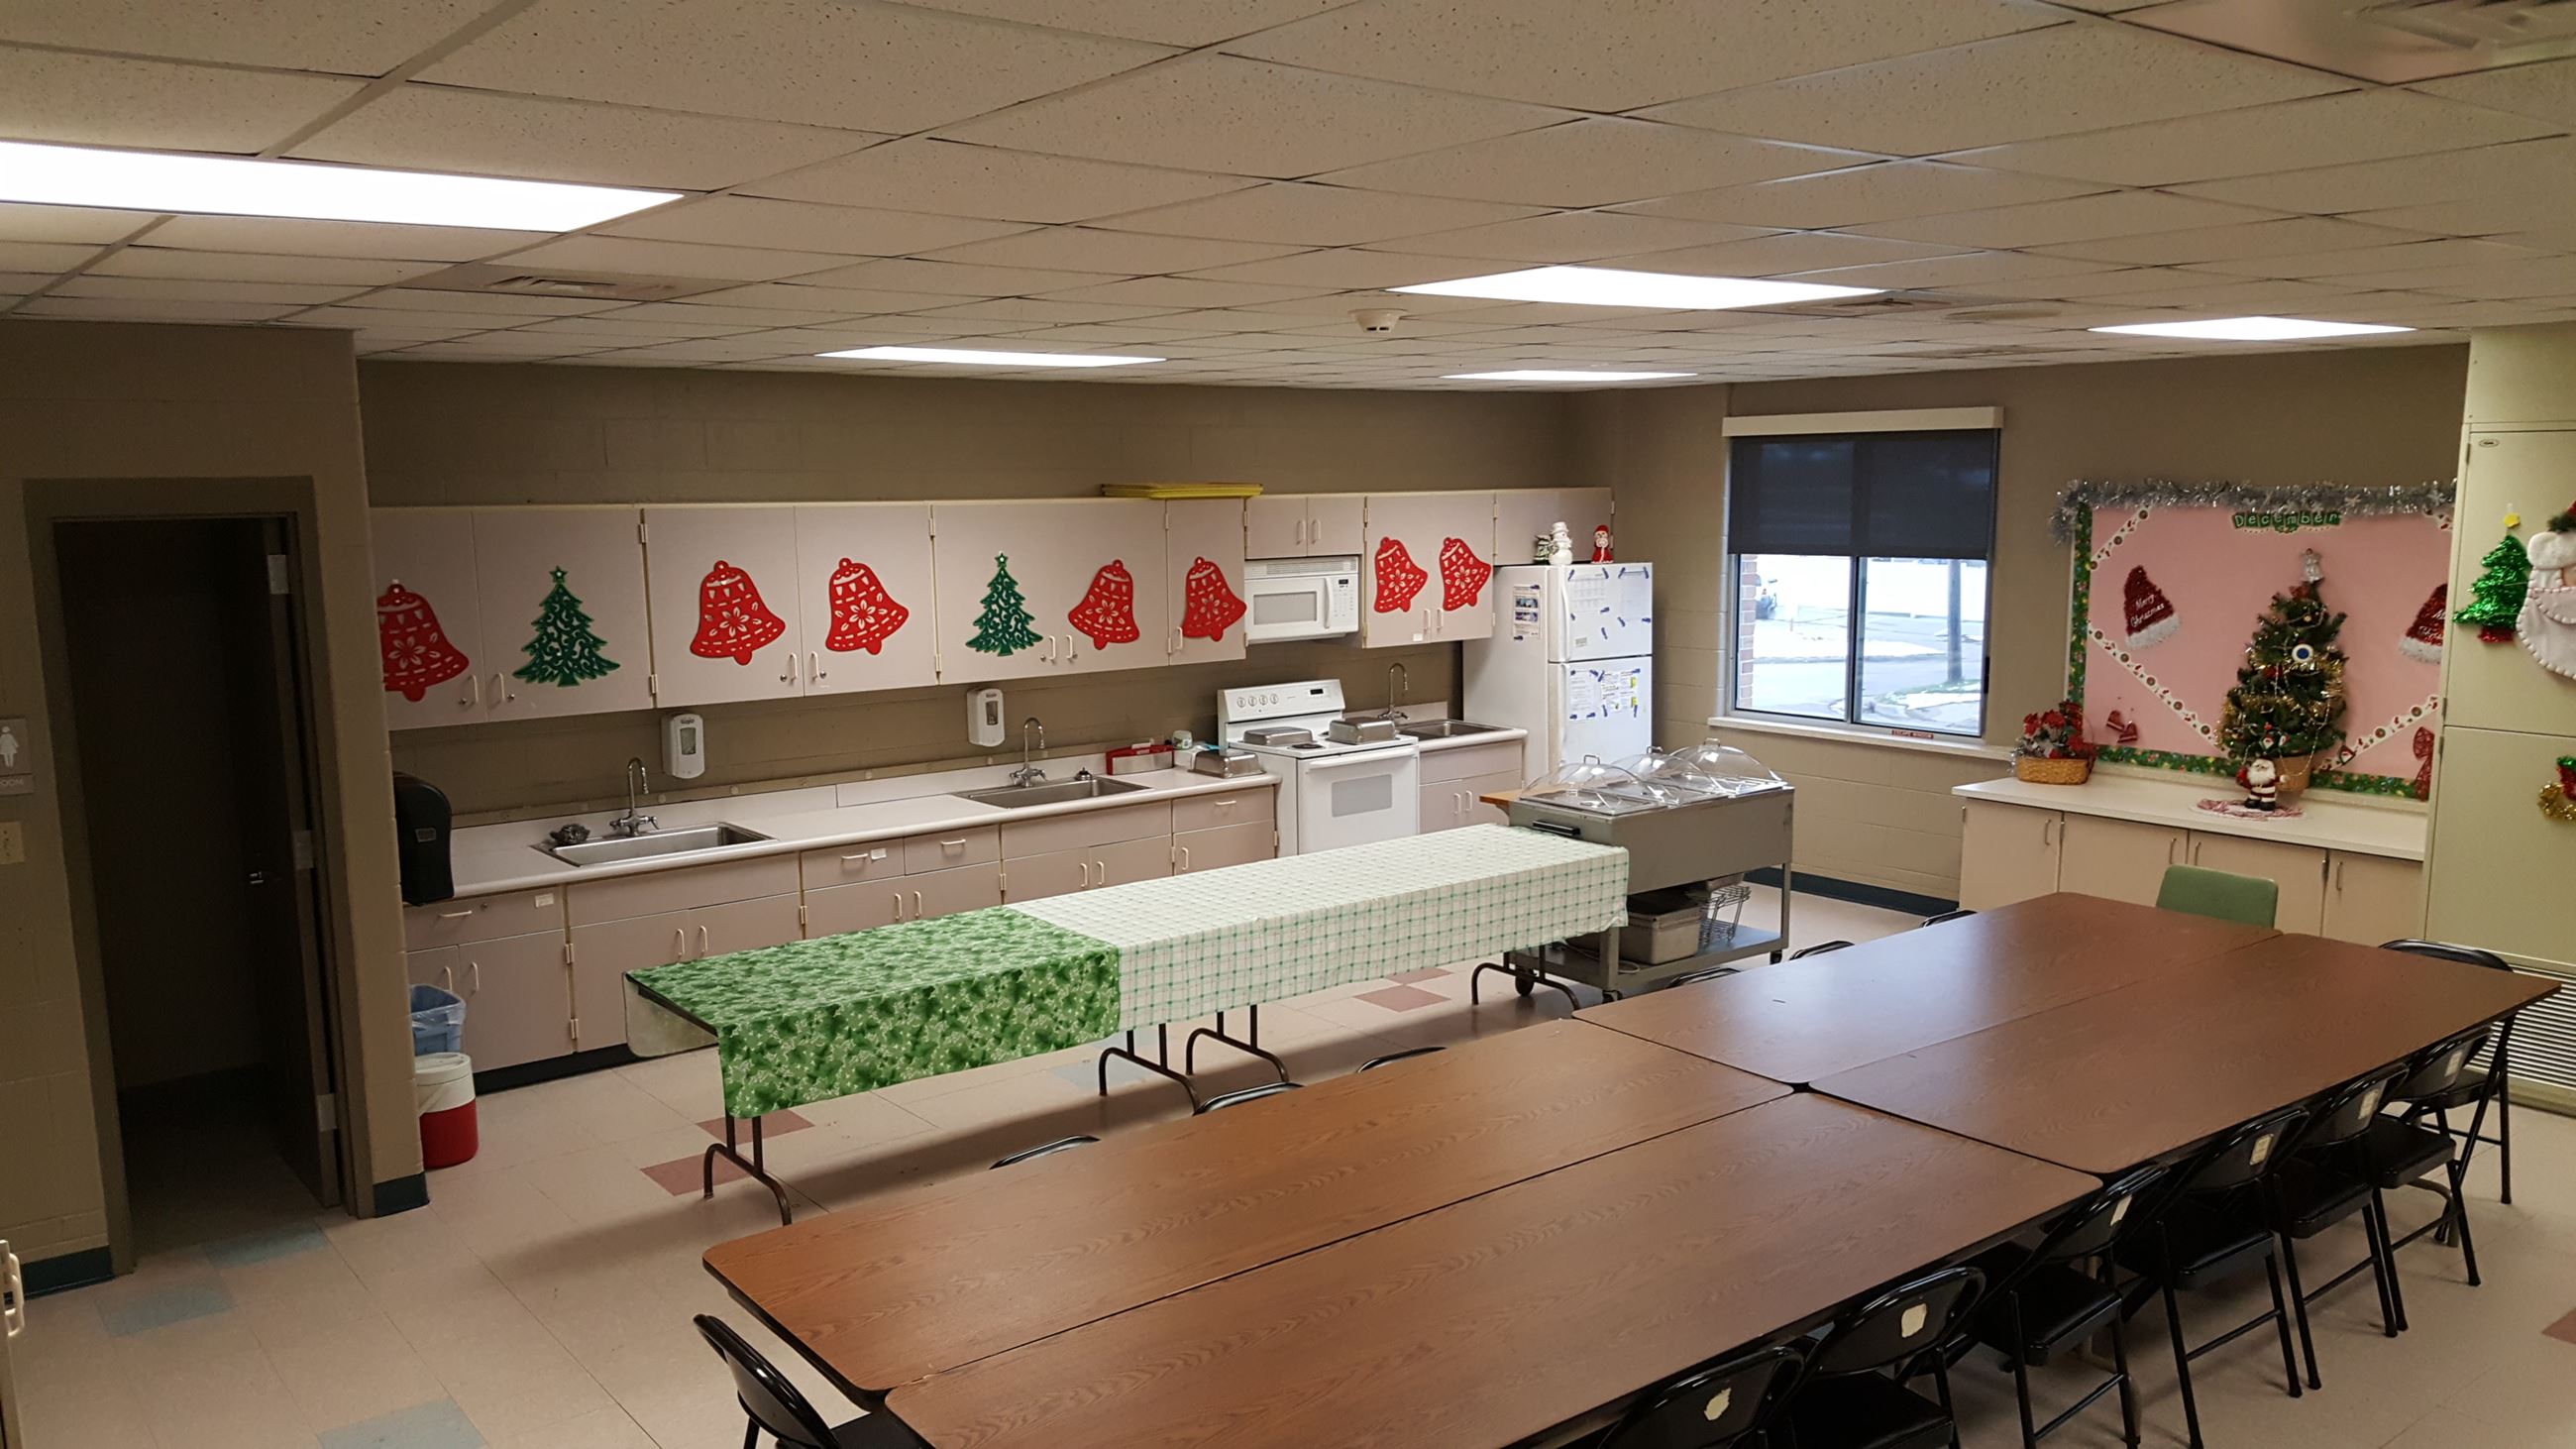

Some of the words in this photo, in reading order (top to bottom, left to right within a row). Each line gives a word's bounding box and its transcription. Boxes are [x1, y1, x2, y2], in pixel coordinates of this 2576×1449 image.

[2235, 512, 2338, 527] December
[2135, 594, 2155, 610] Merry
[2130, 603, 2165, 627] Christmas
[0, 777, 24, 786] OOM
